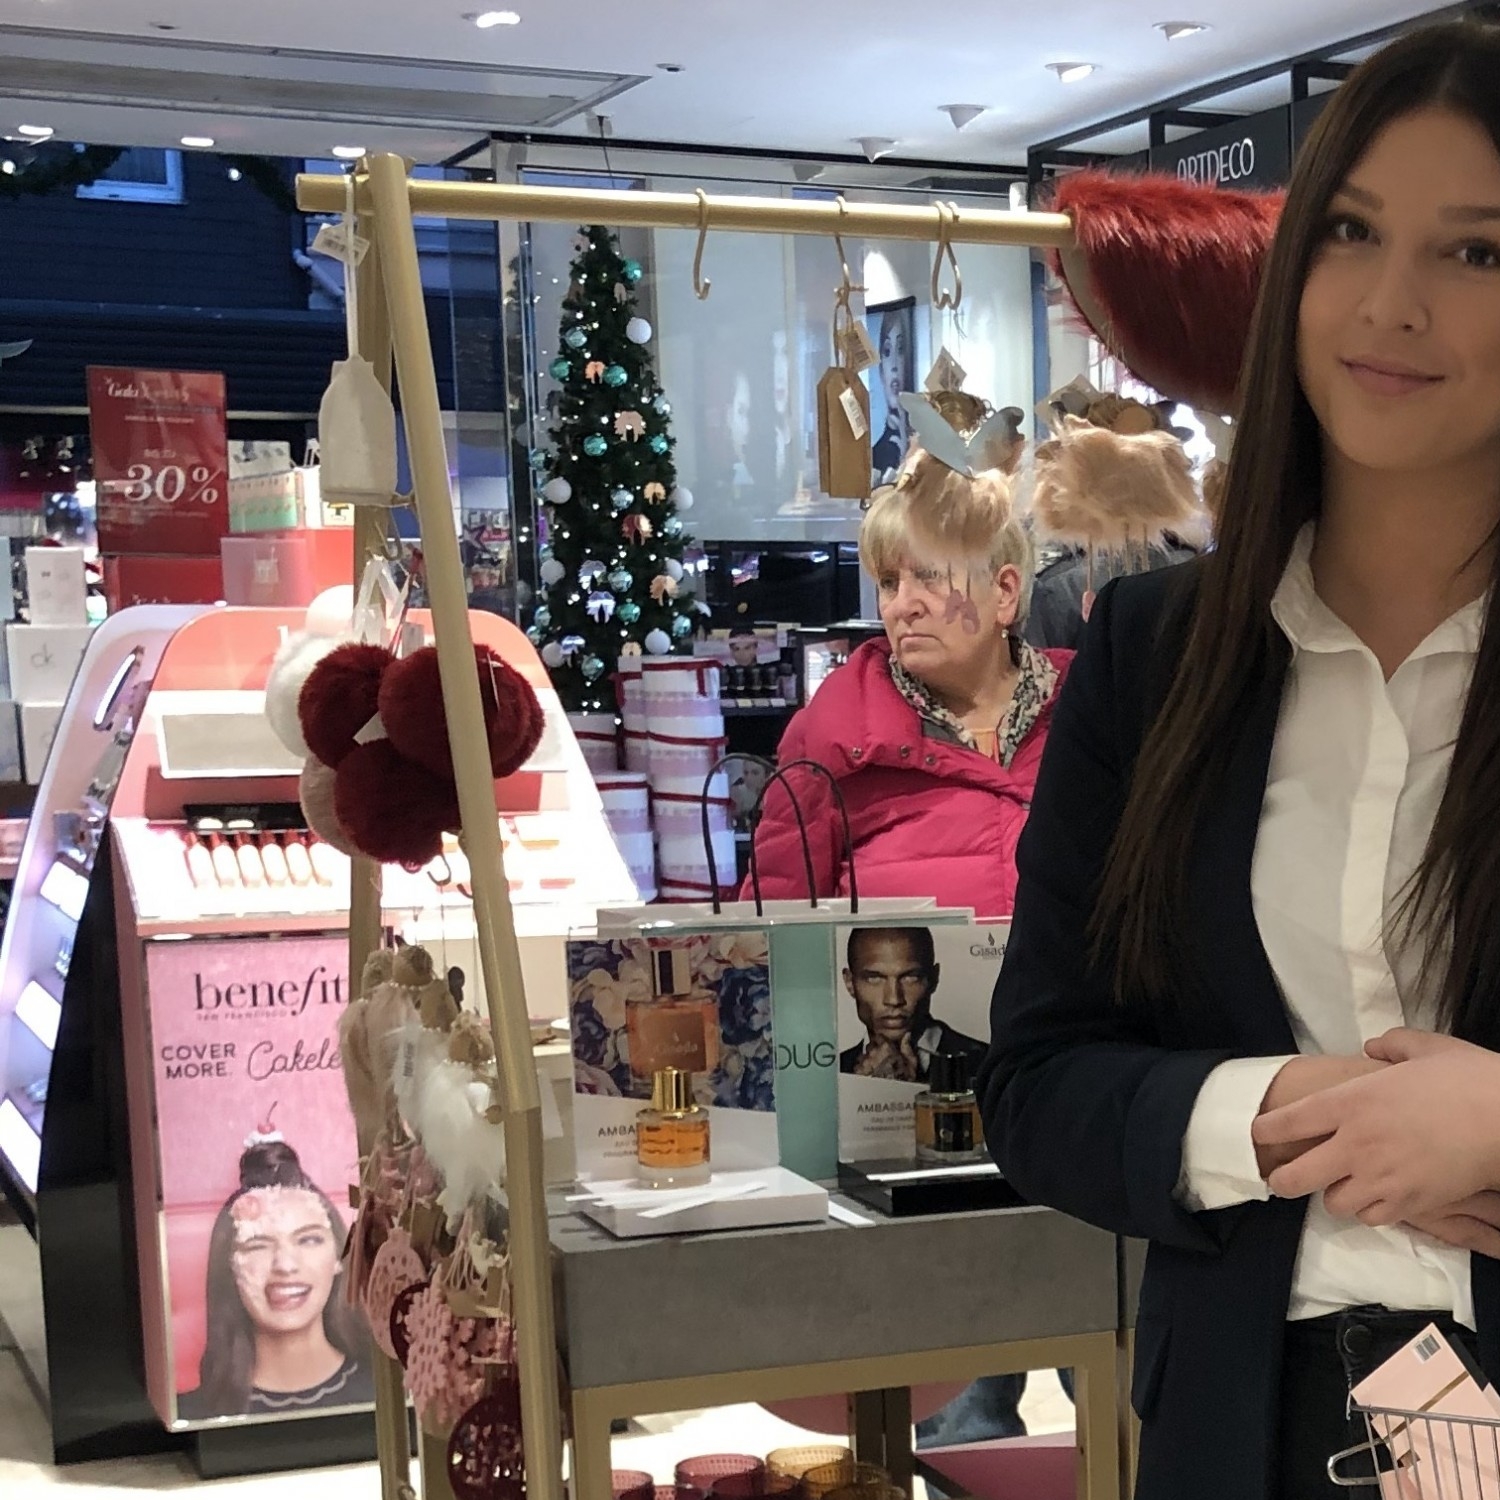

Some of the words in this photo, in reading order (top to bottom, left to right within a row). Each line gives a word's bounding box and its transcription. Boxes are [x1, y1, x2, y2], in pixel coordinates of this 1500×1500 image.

[1177, 137, 1255, 190] ARTDECO
[969, 943, 1006, 957] Gisad
[194, 966, 350, 1016] benefit
[161, 1042, 236, 1062] COVER
[247, 1038, 343, 1081] Cakele
[857, 1102, 914, 1113] AMBASSA
[598, 1125, 636, 1138] AMBA
